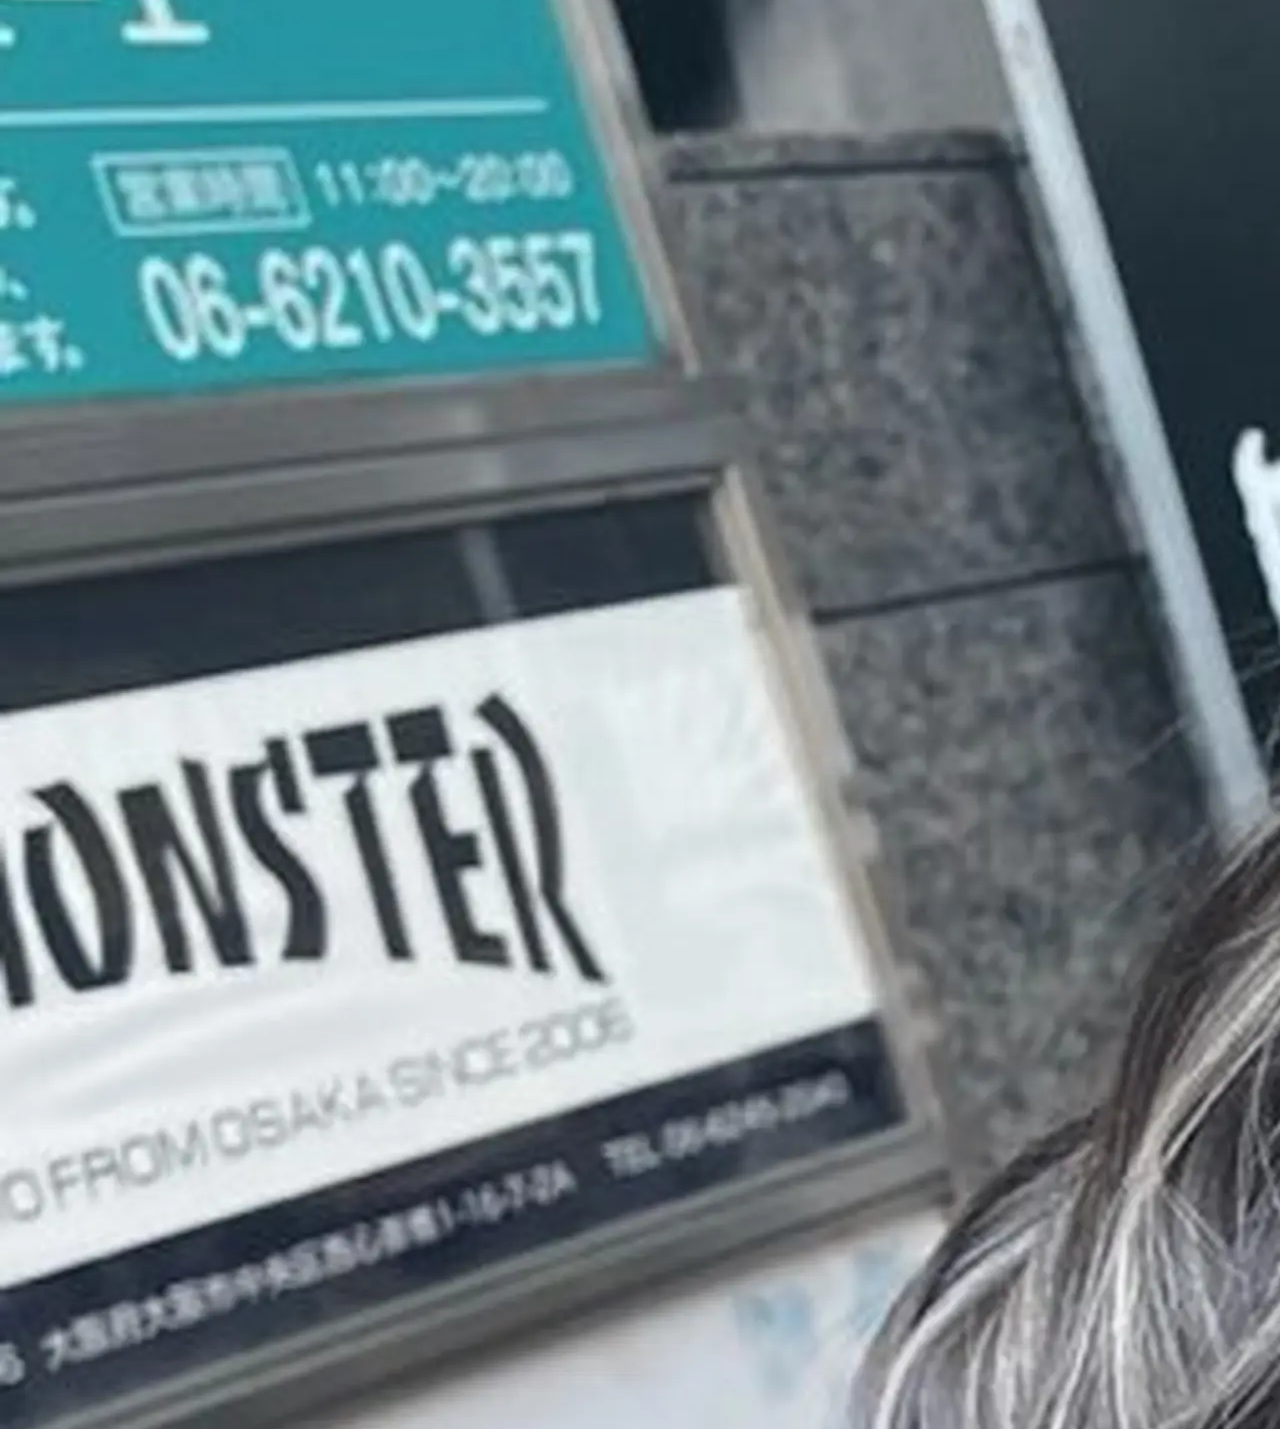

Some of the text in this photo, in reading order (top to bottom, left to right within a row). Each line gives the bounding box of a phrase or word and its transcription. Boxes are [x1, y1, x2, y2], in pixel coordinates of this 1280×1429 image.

[137, 231, 602, 360] 06-6210-3557
[48, 1113, 210, 1212] FROM
[209, 1069, 386, 1159] OSAKA
[386, 1026, 517, 1107] SINCE
